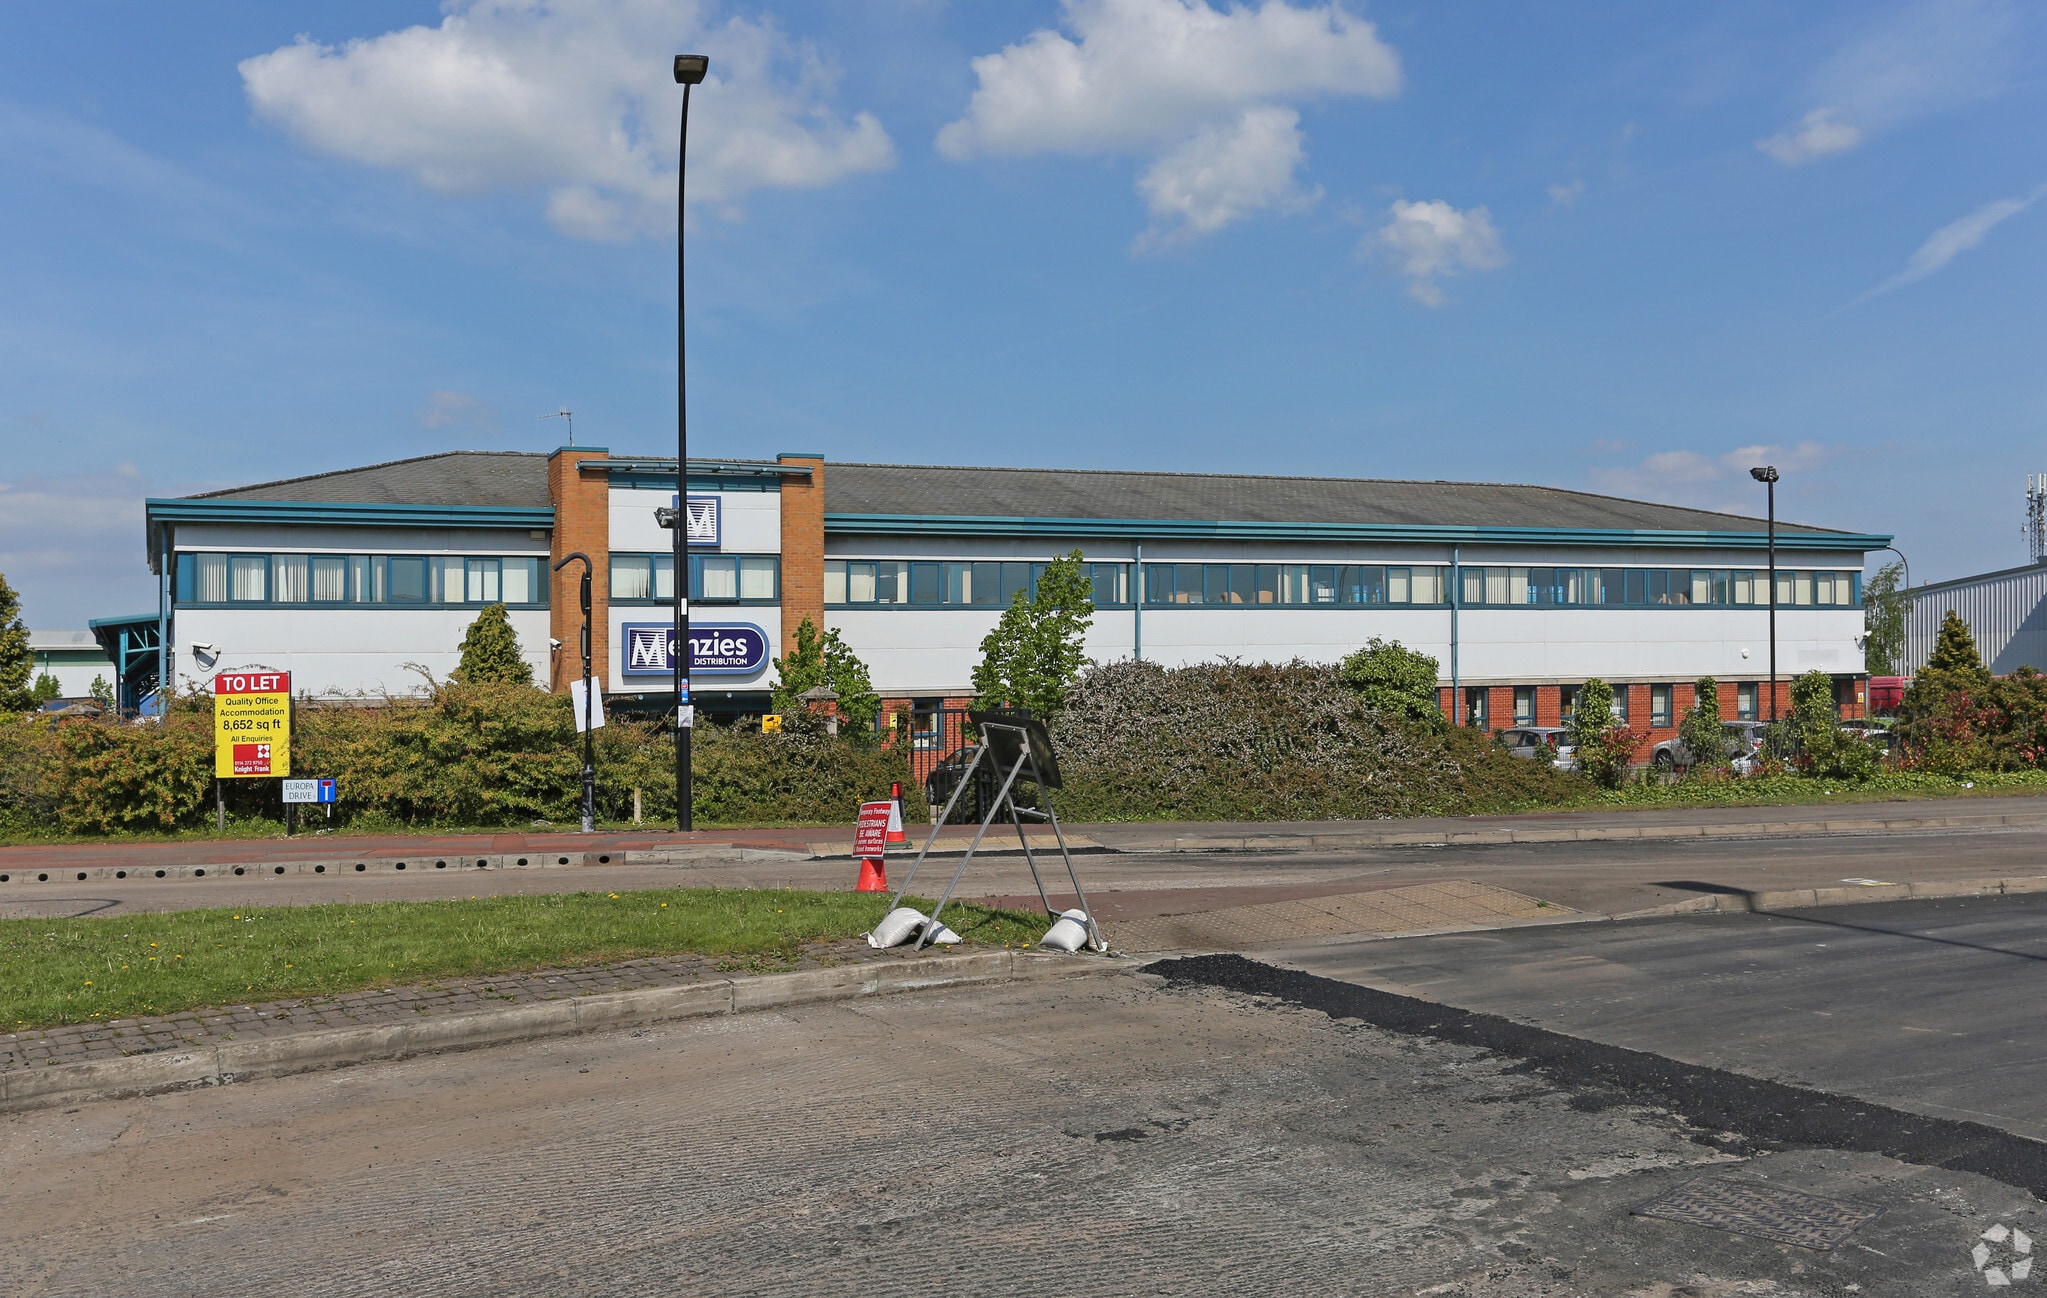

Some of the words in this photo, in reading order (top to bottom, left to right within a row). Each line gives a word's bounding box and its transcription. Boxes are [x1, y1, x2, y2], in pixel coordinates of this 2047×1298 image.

[631, 631, 747, 666] Menzies
[694, 657, 748, 665] DISTRIBUTION
[222, 676, 246, 691] TO
[250, 675, 280, 690] LET
[225, 697, 253, 706] Quality
[255, 697, 278, 705] Office
[220, 708, 285, 717] Accommodation
[223, 719, 253, 731] 8,652
[256, 721, 269, 731] sq
[272, 719, 281, 729] ft
[241, 735, 273, 743] Enquiries
[285, 782, 314, 790] EUROPA
[865, 829, 881, 837] AWARE
